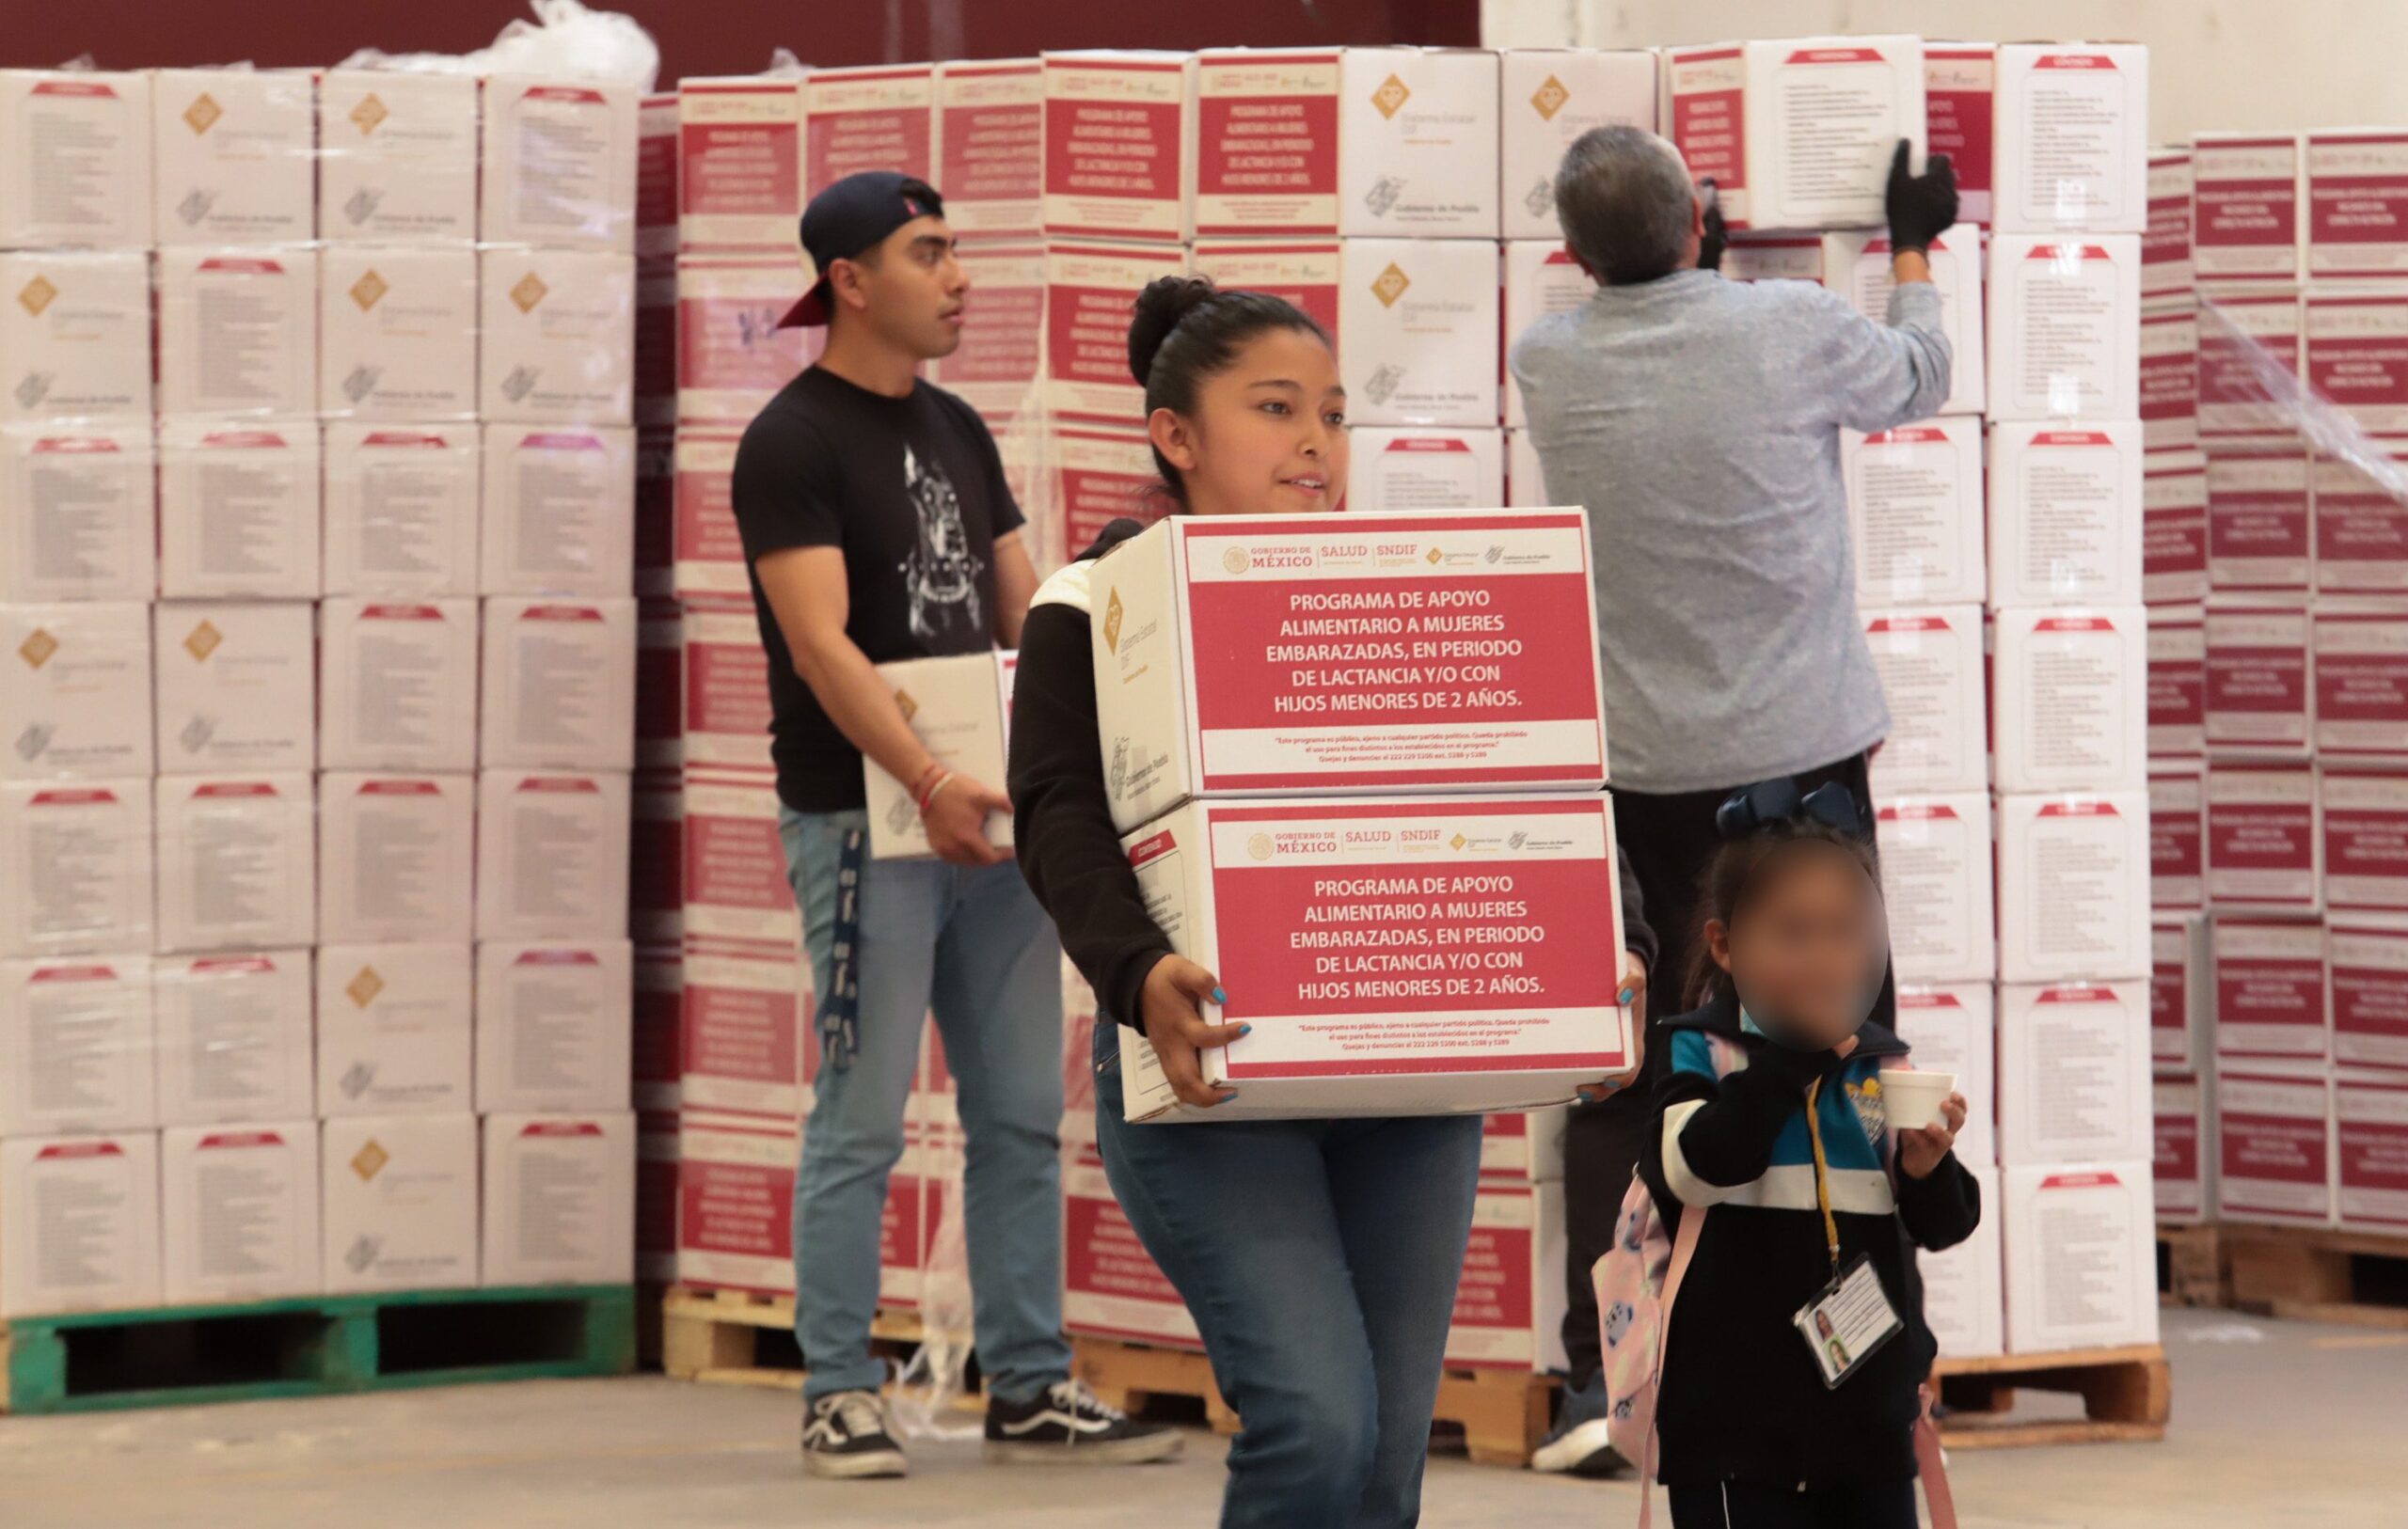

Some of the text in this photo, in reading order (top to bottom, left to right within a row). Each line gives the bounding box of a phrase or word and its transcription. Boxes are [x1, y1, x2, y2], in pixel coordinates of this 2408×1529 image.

[1321, 545, 1368, 557] SALUD
[1376, 544, 1418, 556] SNDIF
[1252, 555, 1313, 568] MÉXICO
[1291, 590, 1490, 610] PROGRAMA DE APOYO
[1280, 615, 1504, 636] ALIMENTARIO A MUJERES
[1267, 639, 1522, 662] EMBARAZADAS, EN PERIODO
[1292, 666, 1499, 686] DE LACTANCIA Y/O CON
[1275, 688, 1522, 712] HIJOS MENORES DE 2 AÑOS.
[1345, 830, 1391, 843] SALUD
[1401, 829, 1441, 841] SNDIF
[1276, 840, 1337, 853] MÉXICO
[1315, 876, 1513, 896] PROGRAMA DE APOYO
[1305, 901, 1527, 922] ALIMENTARIO A MUJERES
[1291, 926, 1545, 948] EMBARAZADAS, EN PERIODO
[1316, 953, 1523, 973] DE LACTANCIA Y/O CON
[1299, 975, 1545, 999] HIJOS MENORES DE 2 AÑOS.
